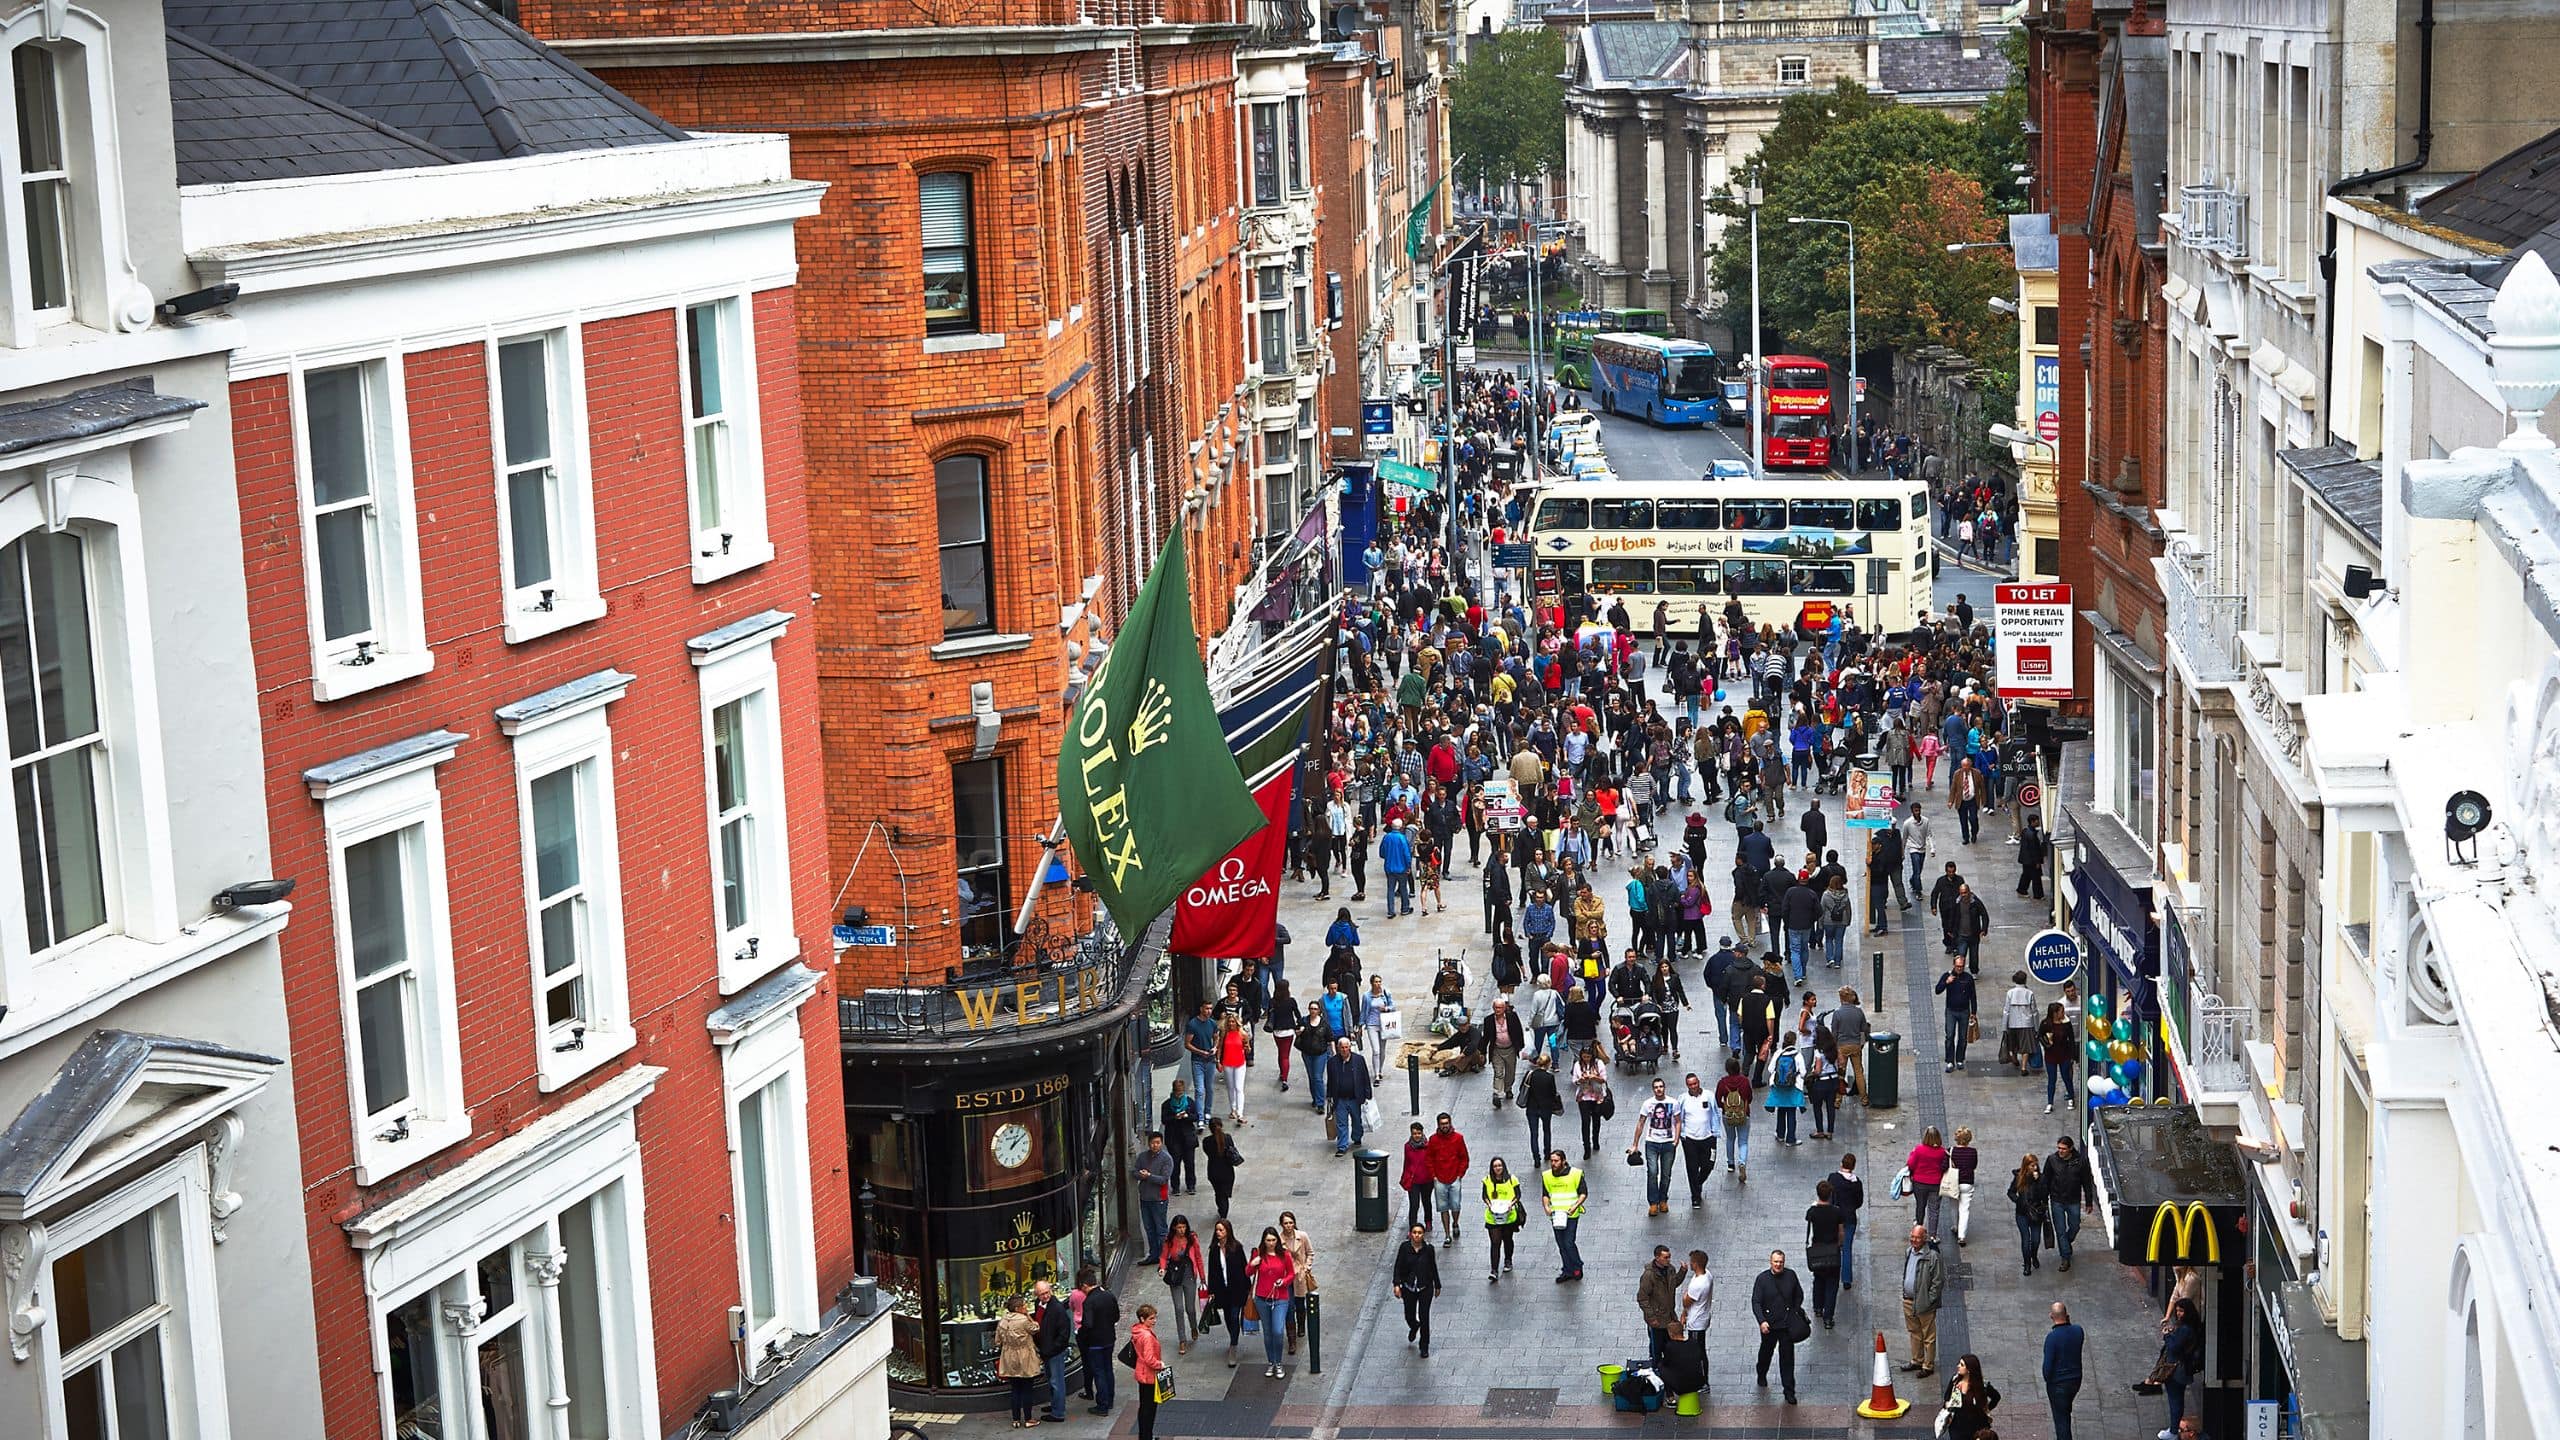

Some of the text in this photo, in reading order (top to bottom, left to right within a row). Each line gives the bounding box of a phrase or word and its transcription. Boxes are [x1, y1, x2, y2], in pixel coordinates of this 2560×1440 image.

[1590, 536, 1656, 552] day tours
[2010, 589, 2056, 600] TO LET
[2023, 661, 2046, 671] Lisney
[1080, 645, 1143, 894] ROLEX
[1187, 876, 1271, 908] OMEGA
[2035, 944, 2071, 956] HEALTH
[2032, 957, 2077, 972] MATTERS
[954, 966, 1100, 1031] WEIR
[956, 1074, 1070, 1110] ESTD 1869
[995, 1229, 1052, 1253] ROLEX
